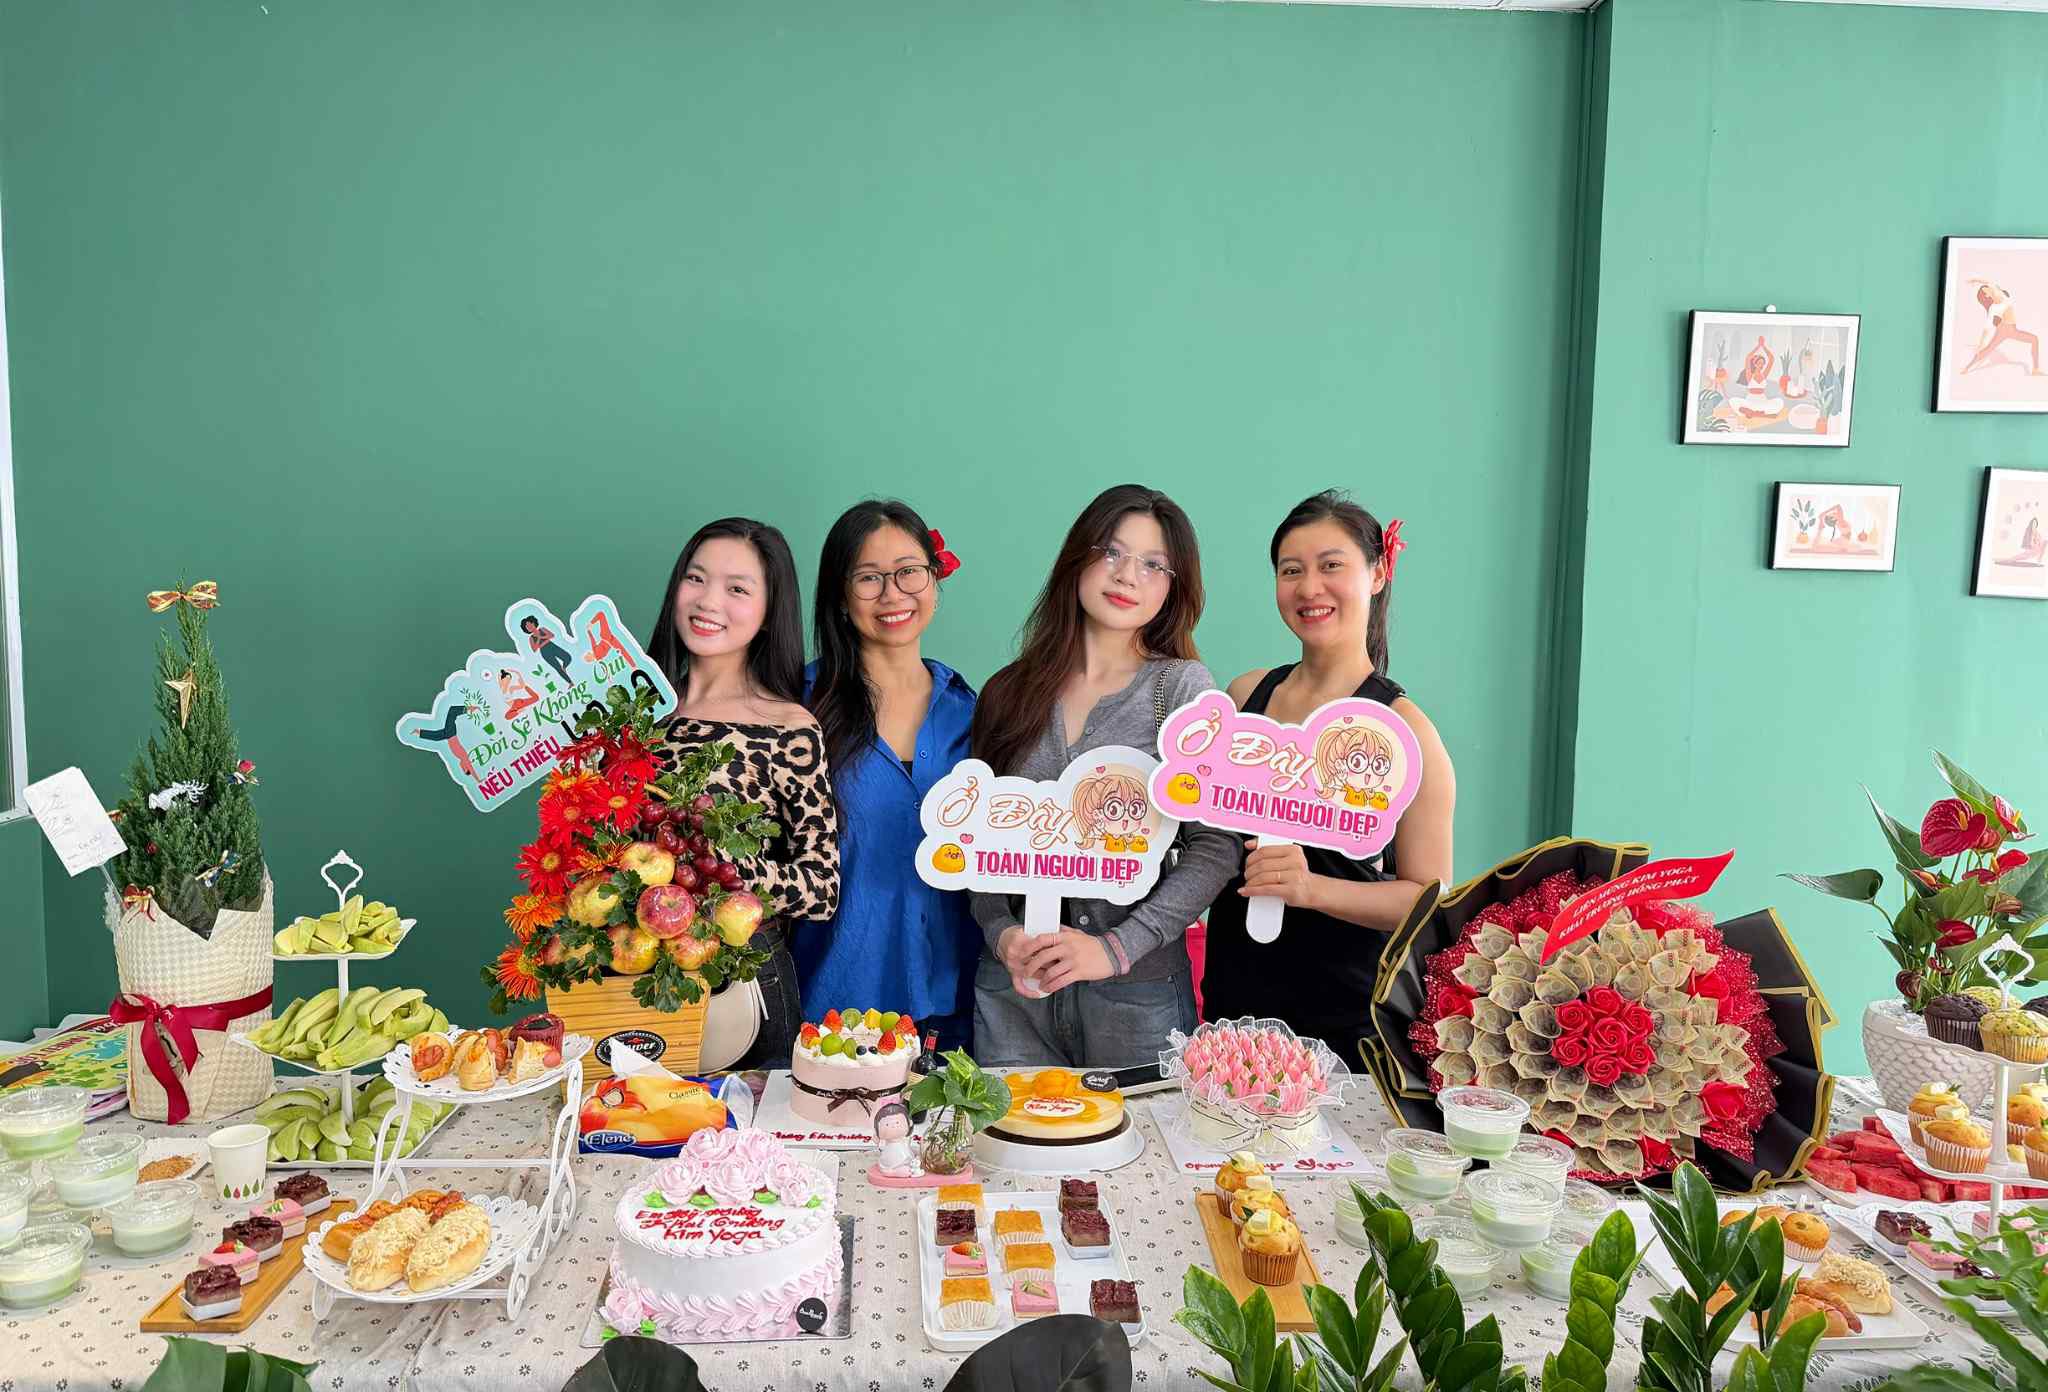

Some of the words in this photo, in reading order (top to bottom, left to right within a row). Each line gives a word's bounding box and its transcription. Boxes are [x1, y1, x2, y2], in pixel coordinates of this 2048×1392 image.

[471, 731, 509, 766] Đời
[532, 680, 593, 727] Không
[478, 767, 514, 801] NẾU
[510, 734, 562, 777] THIẾU
[1228, 730, 1316, 793] Đây
[987, 793, 1075, 850] Đây
[1211, 785, 1265, 817] TOÀN
[1338, 810, 1379, 841] ĐẸP
[976, 849, 1029, 875] TOÀN
[1101, 857, 1142, 887] ĐẸP
[1659, 865, 1694, 878] YOGA
